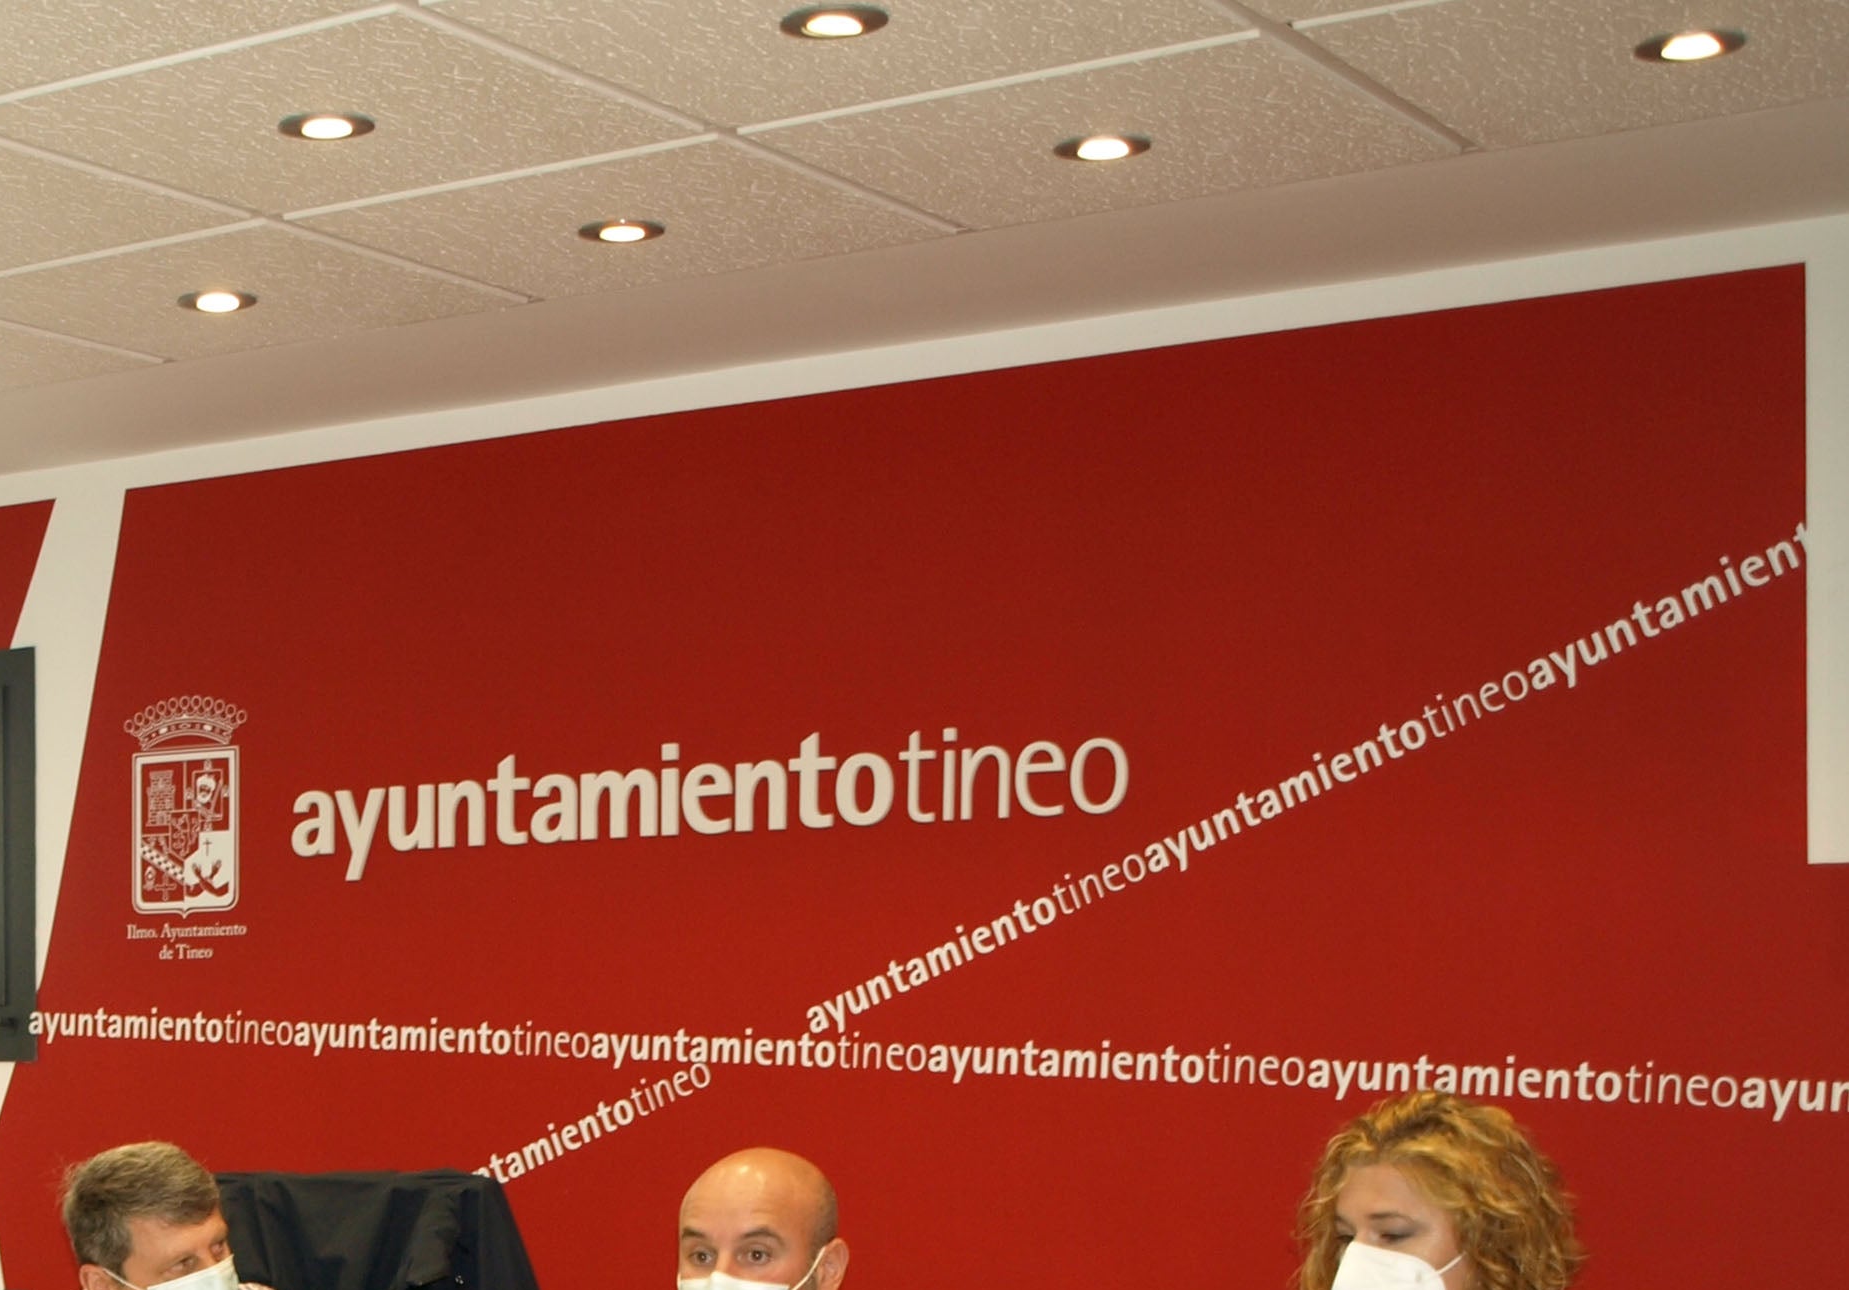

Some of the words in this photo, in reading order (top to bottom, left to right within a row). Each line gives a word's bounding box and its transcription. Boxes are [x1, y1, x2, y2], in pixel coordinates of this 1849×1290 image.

[160, 922, 247, 942] Ayuntamiento
[159, 946, 173, 960] de
[175, 944, 214, 960] Tineo
